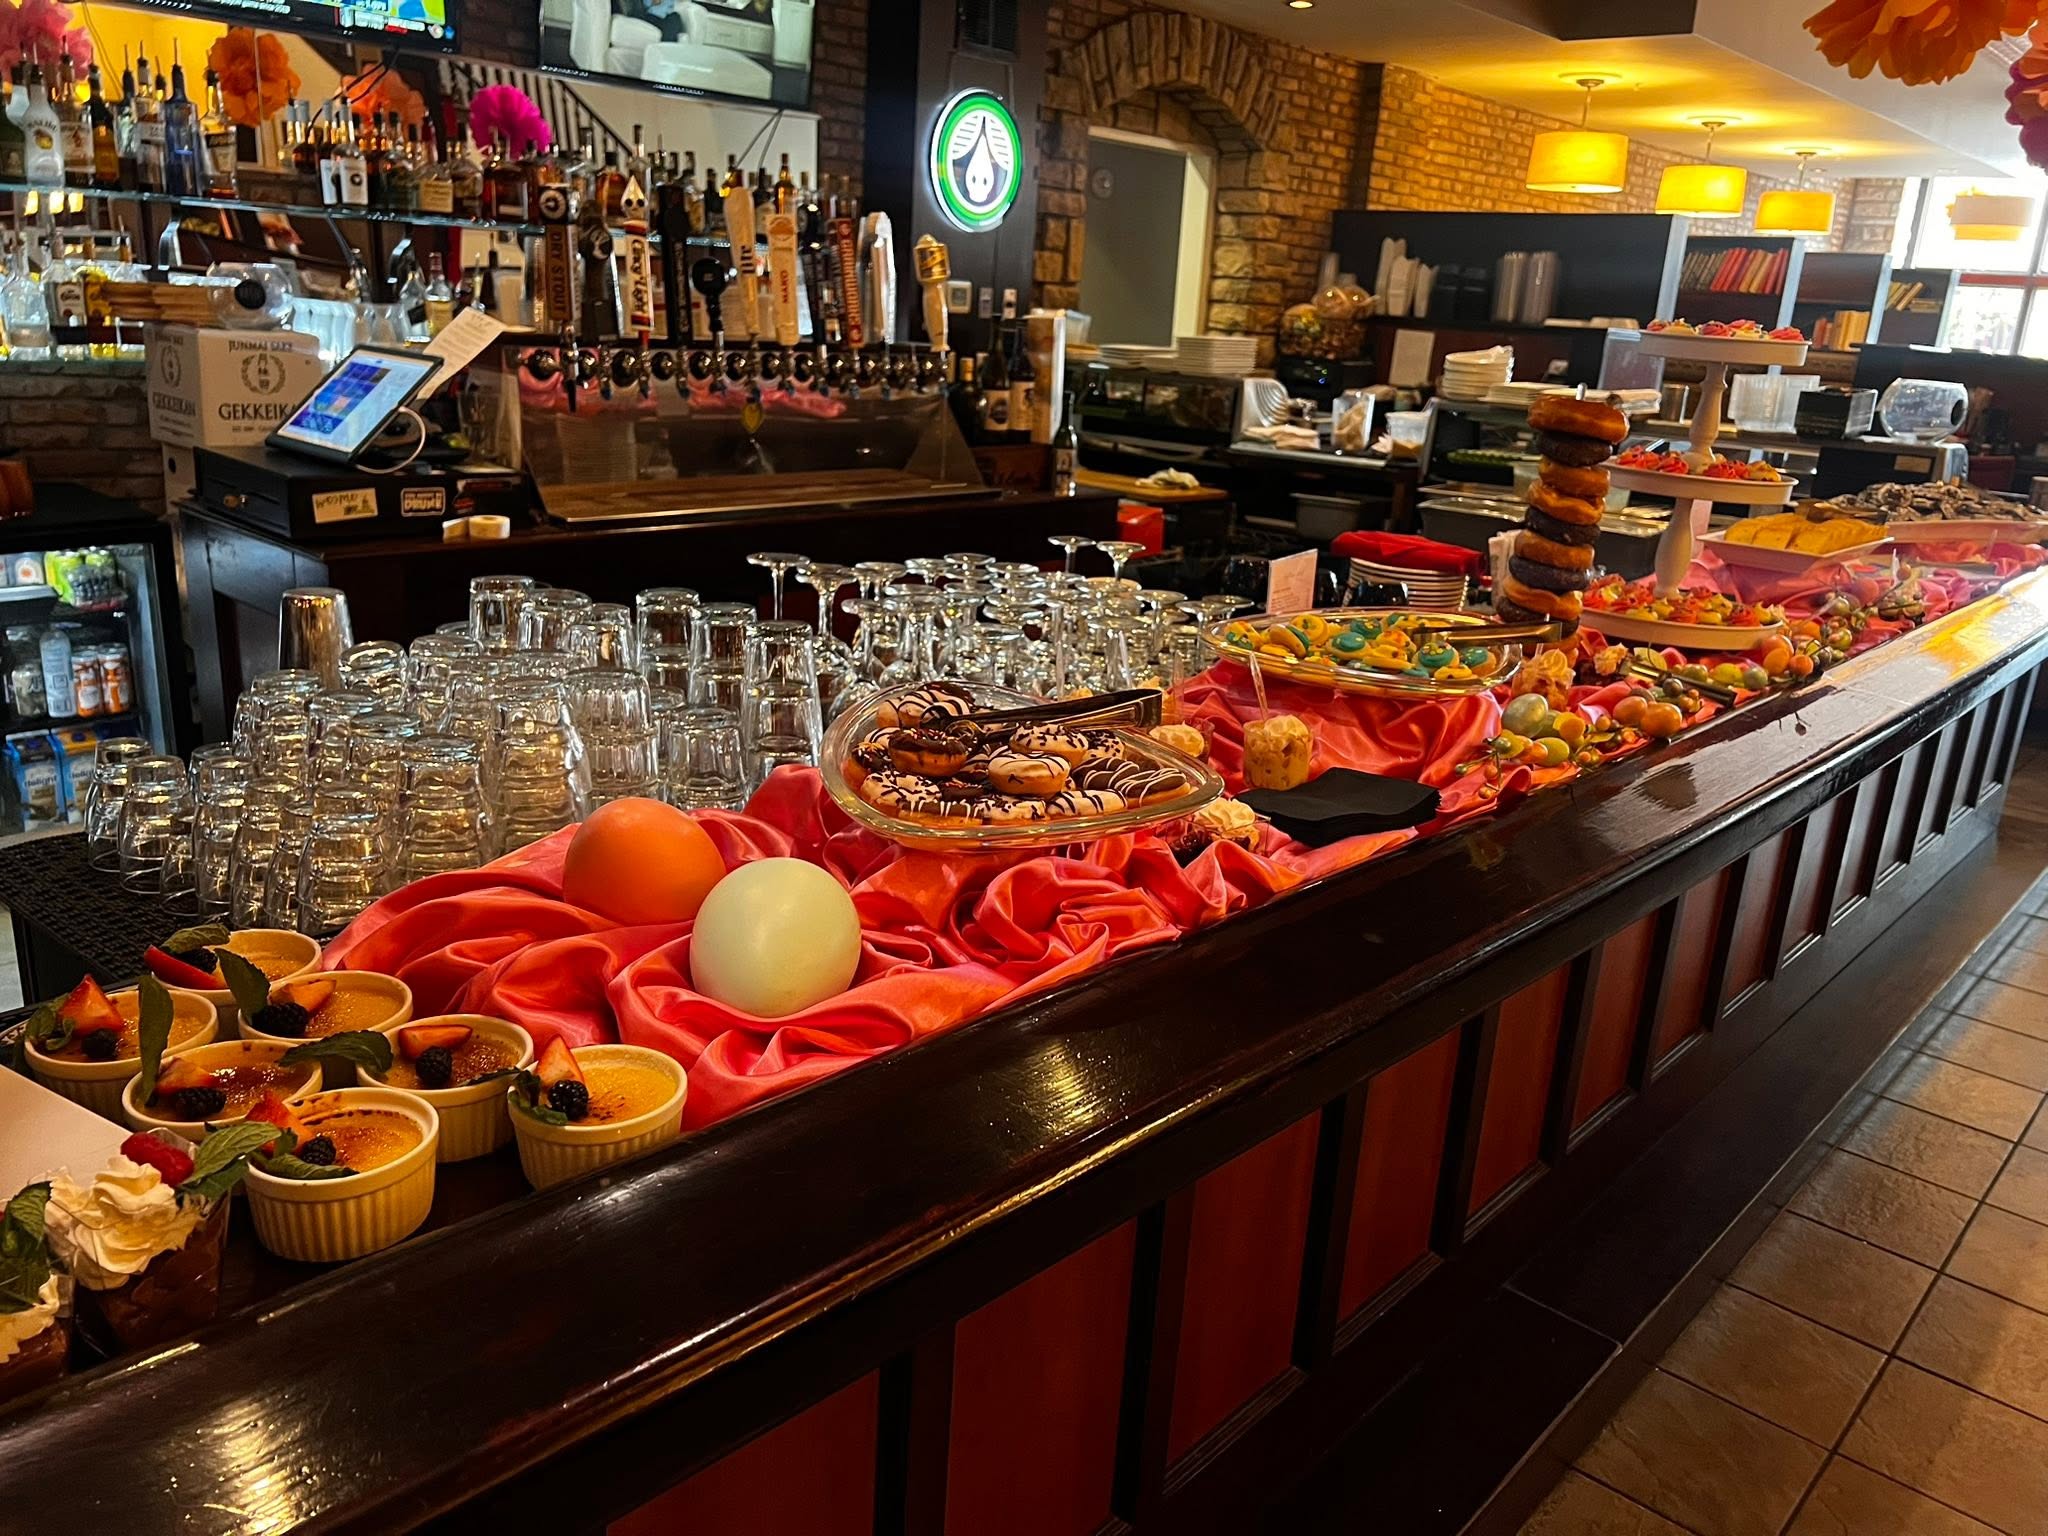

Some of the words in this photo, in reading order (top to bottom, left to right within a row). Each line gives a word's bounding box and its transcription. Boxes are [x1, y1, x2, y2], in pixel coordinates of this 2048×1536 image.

[552, 265, 566, 313] STOUT
[229, 340, 268, 352] JUNMAI
[218, 403, 297, 420] GEKKEIK
